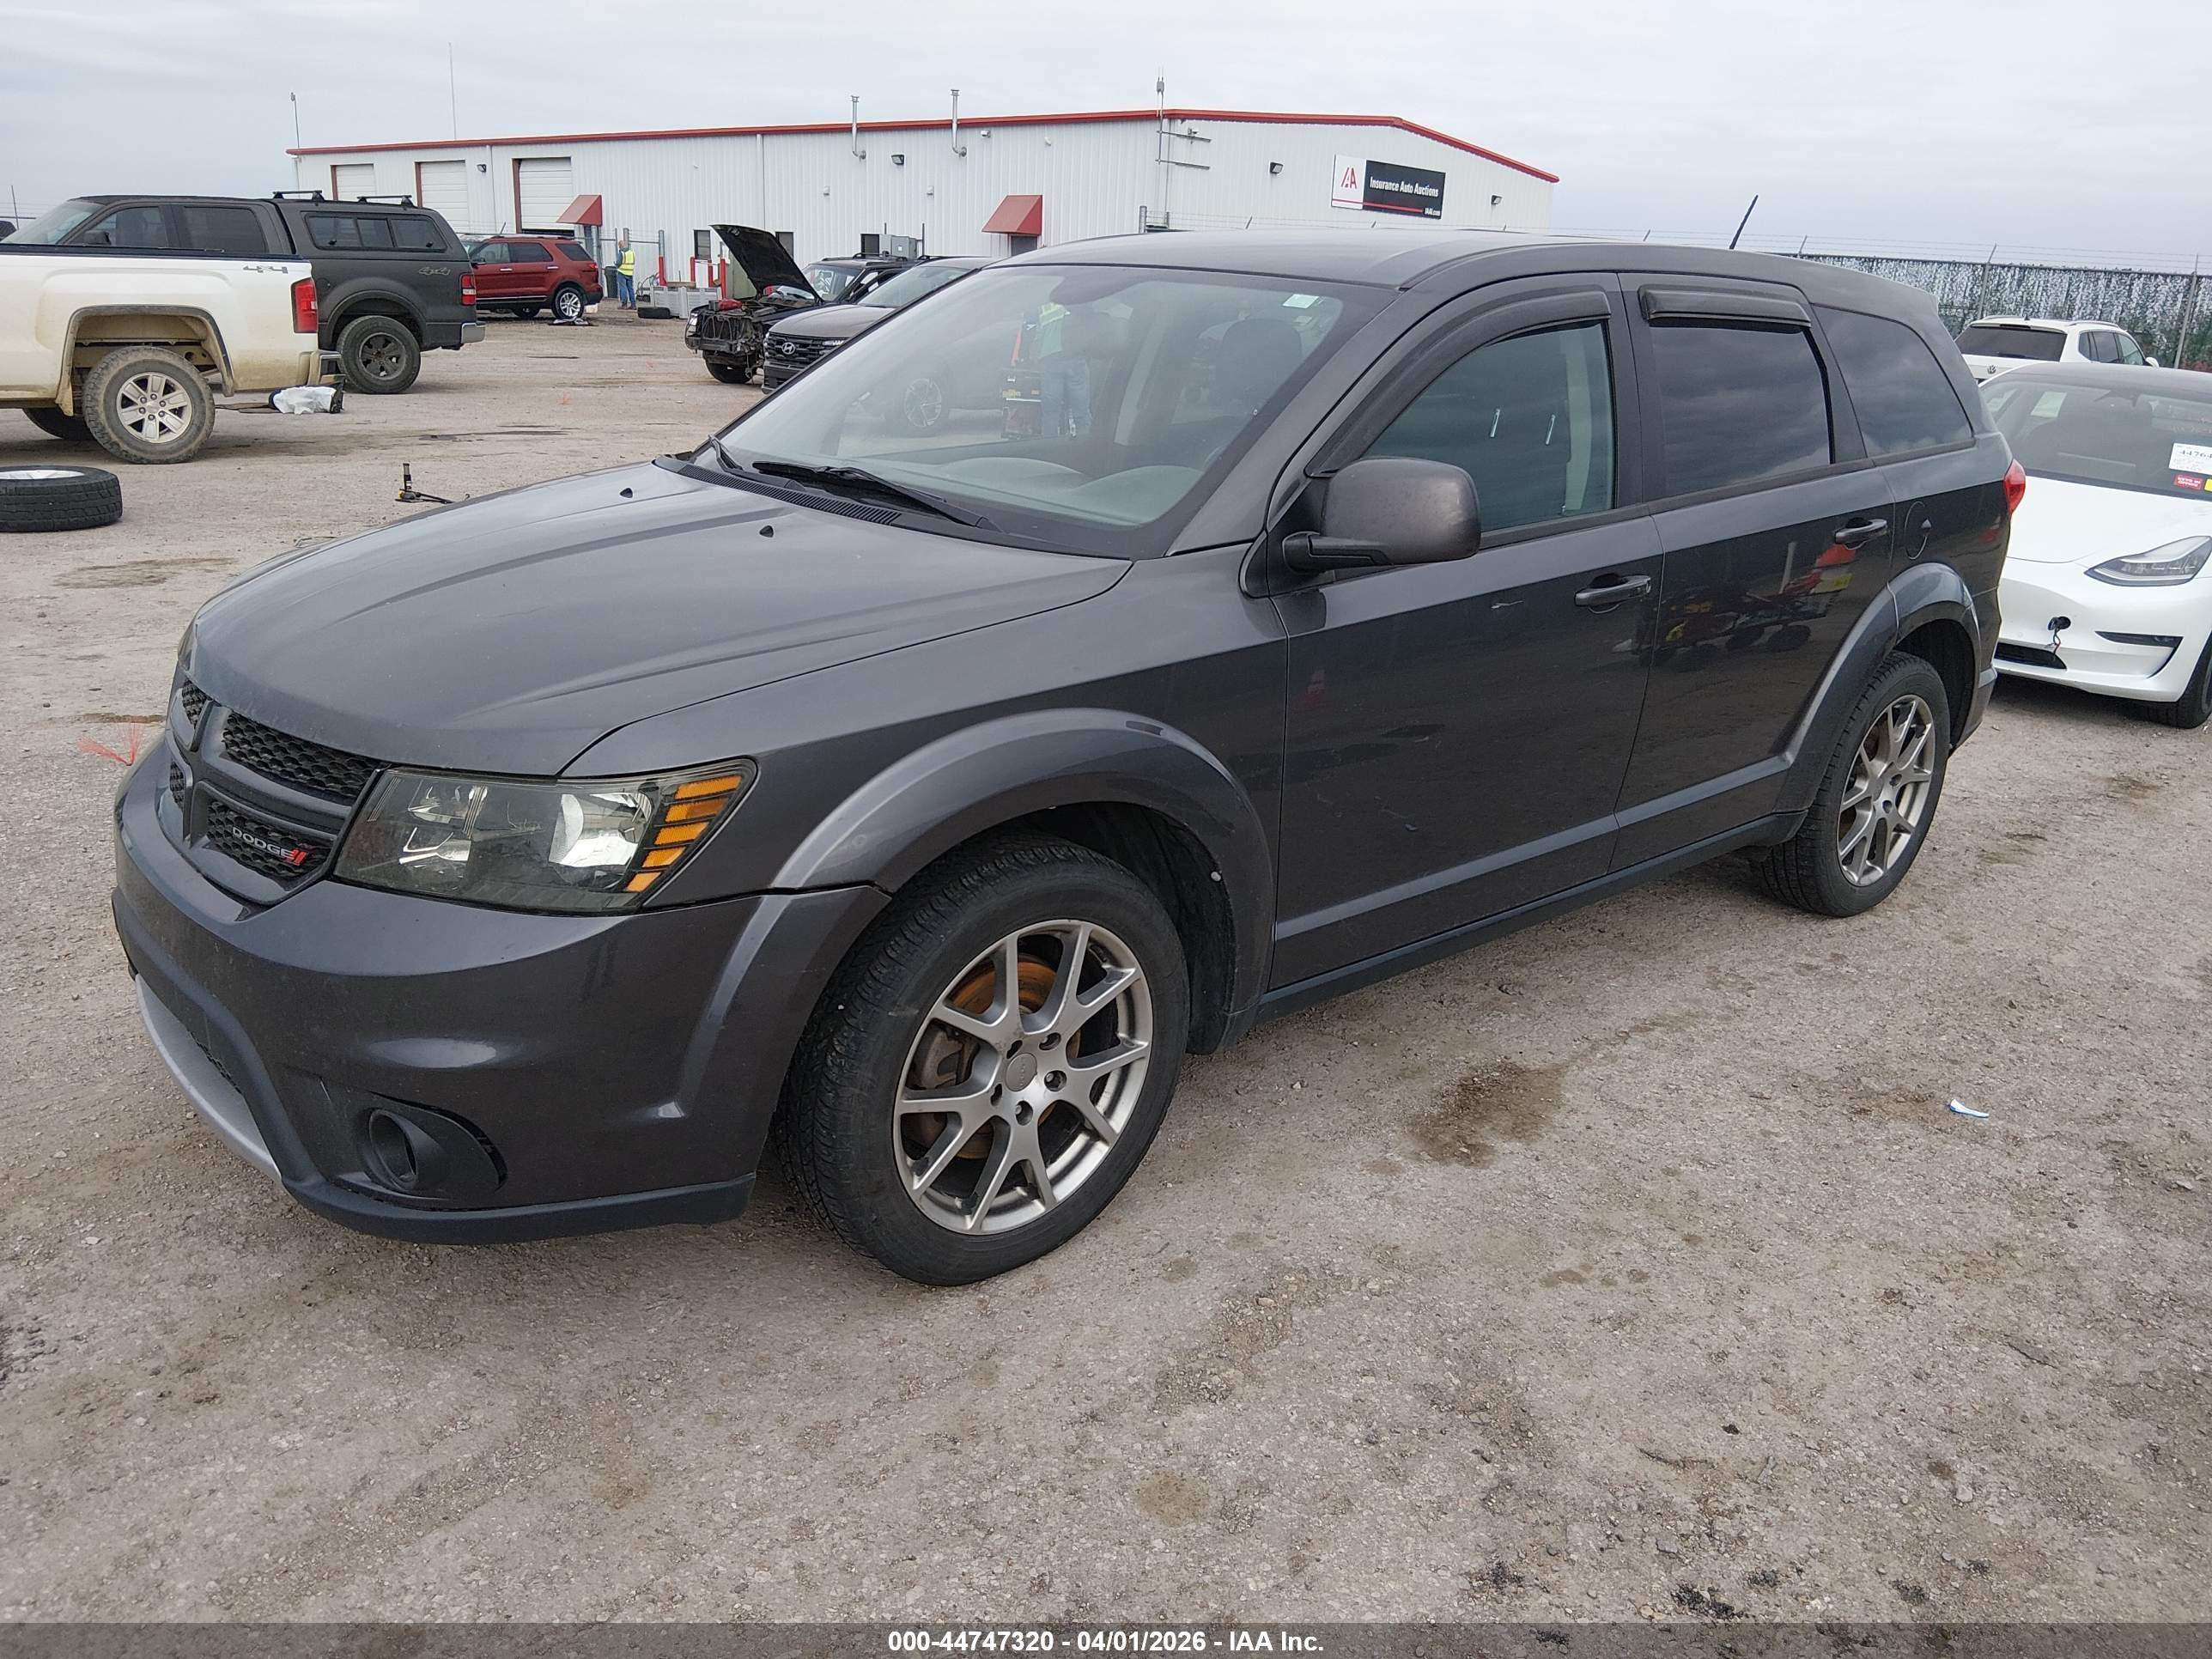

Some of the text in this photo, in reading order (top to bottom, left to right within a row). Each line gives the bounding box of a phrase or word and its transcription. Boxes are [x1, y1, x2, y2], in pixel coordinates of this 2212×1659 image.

[1370, 176, 1439, 198] Insurance Auto Auctions
[232, 826, 295, 861] DODGE
